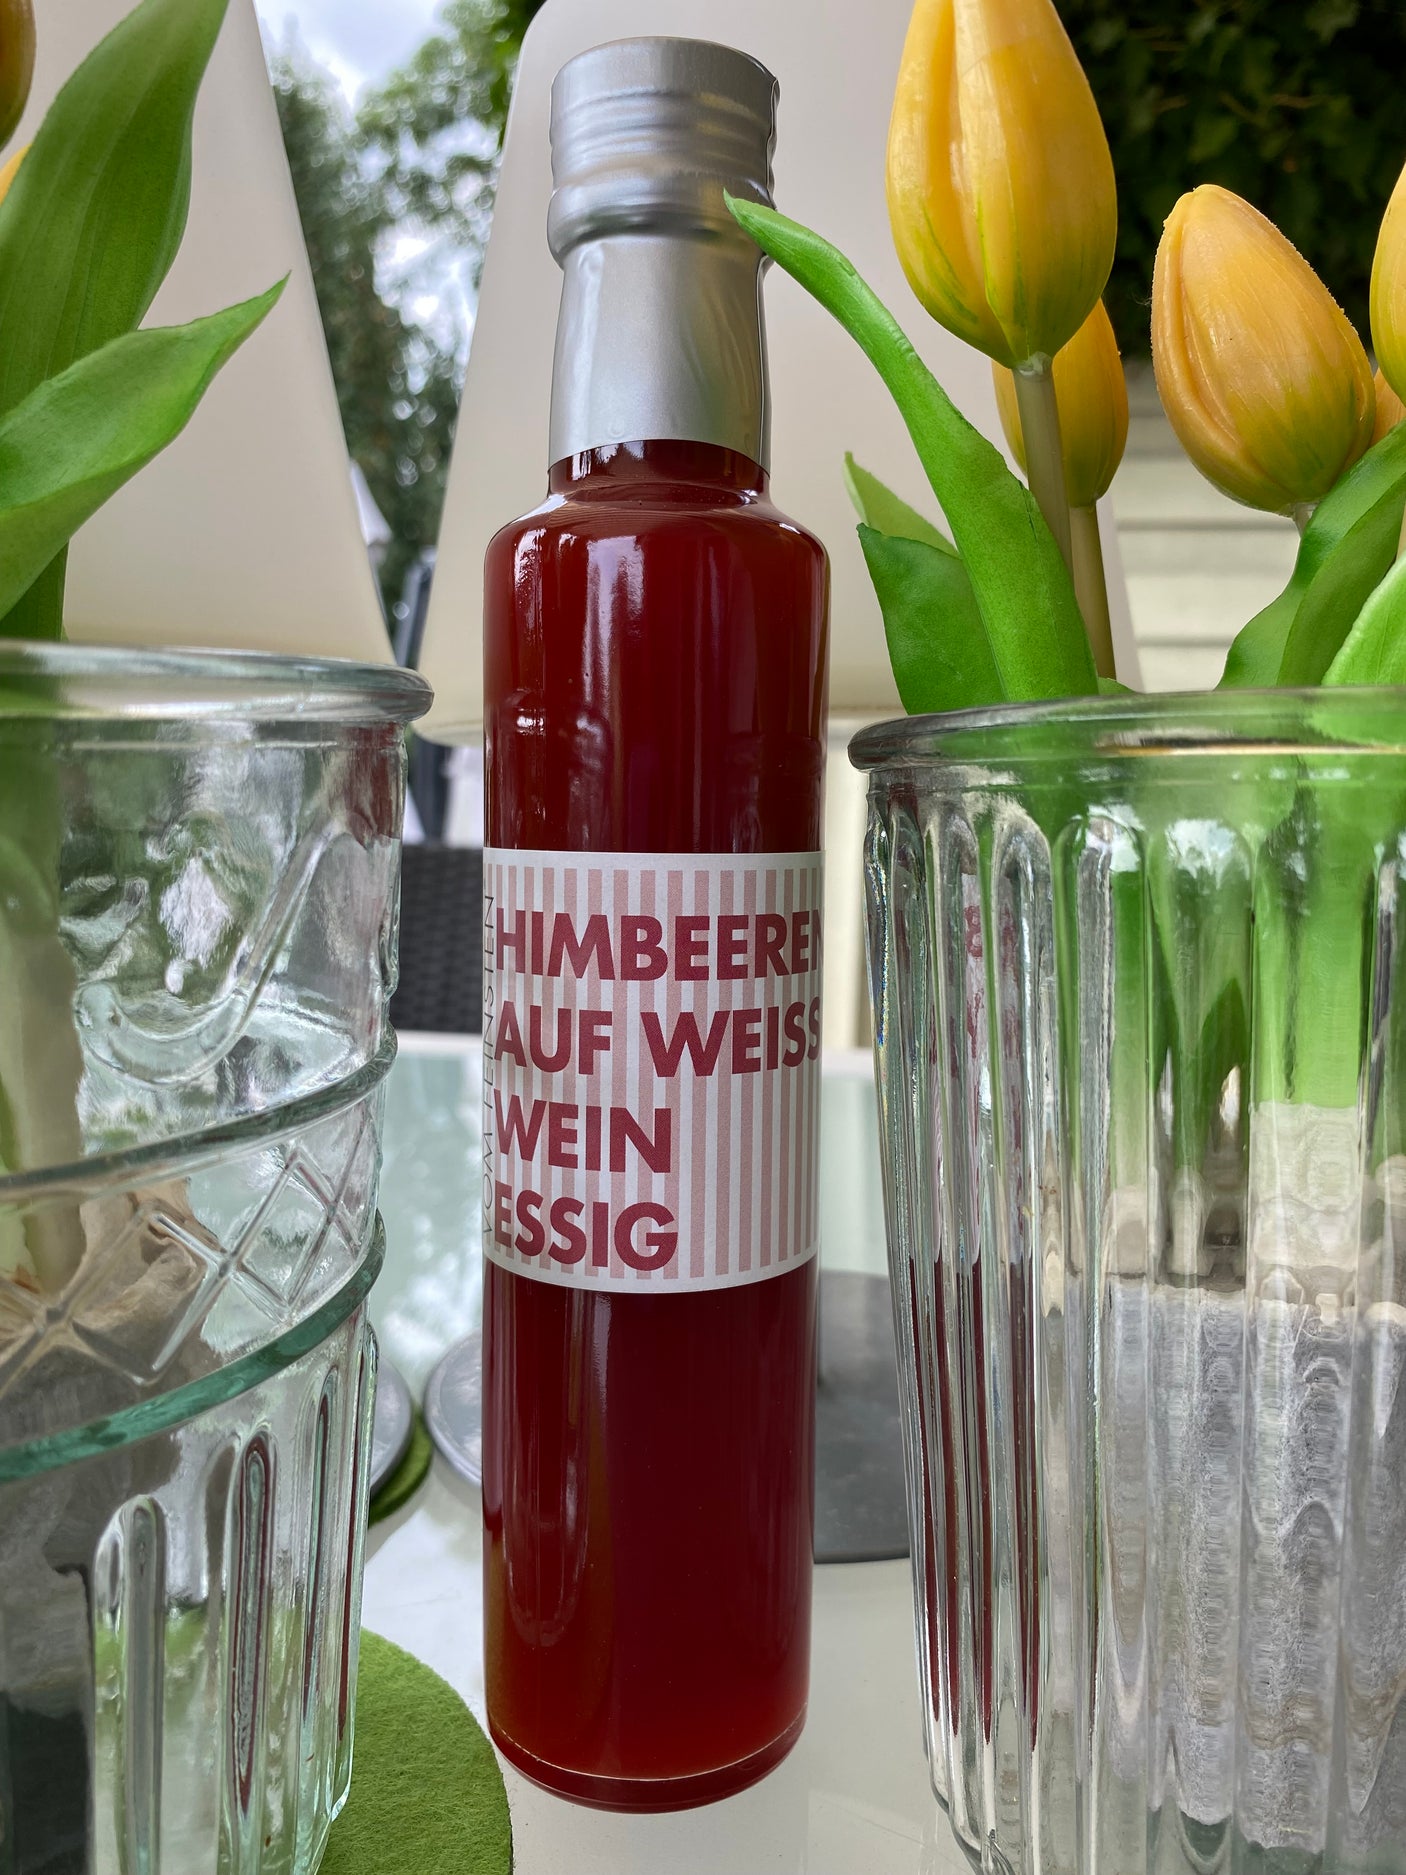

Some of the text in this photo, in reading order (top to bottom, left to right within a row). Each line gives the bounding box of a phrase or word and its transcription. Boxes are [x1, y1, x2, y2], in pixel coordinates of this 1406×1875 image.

[482, 895, 494, 1234] VOM FEINSTEN
[494, 997, 821, 1078] AUF WEISS
[494, 1088, 672, 1173] WEIN
[494, 1180, 678, 1271] ESSIG
